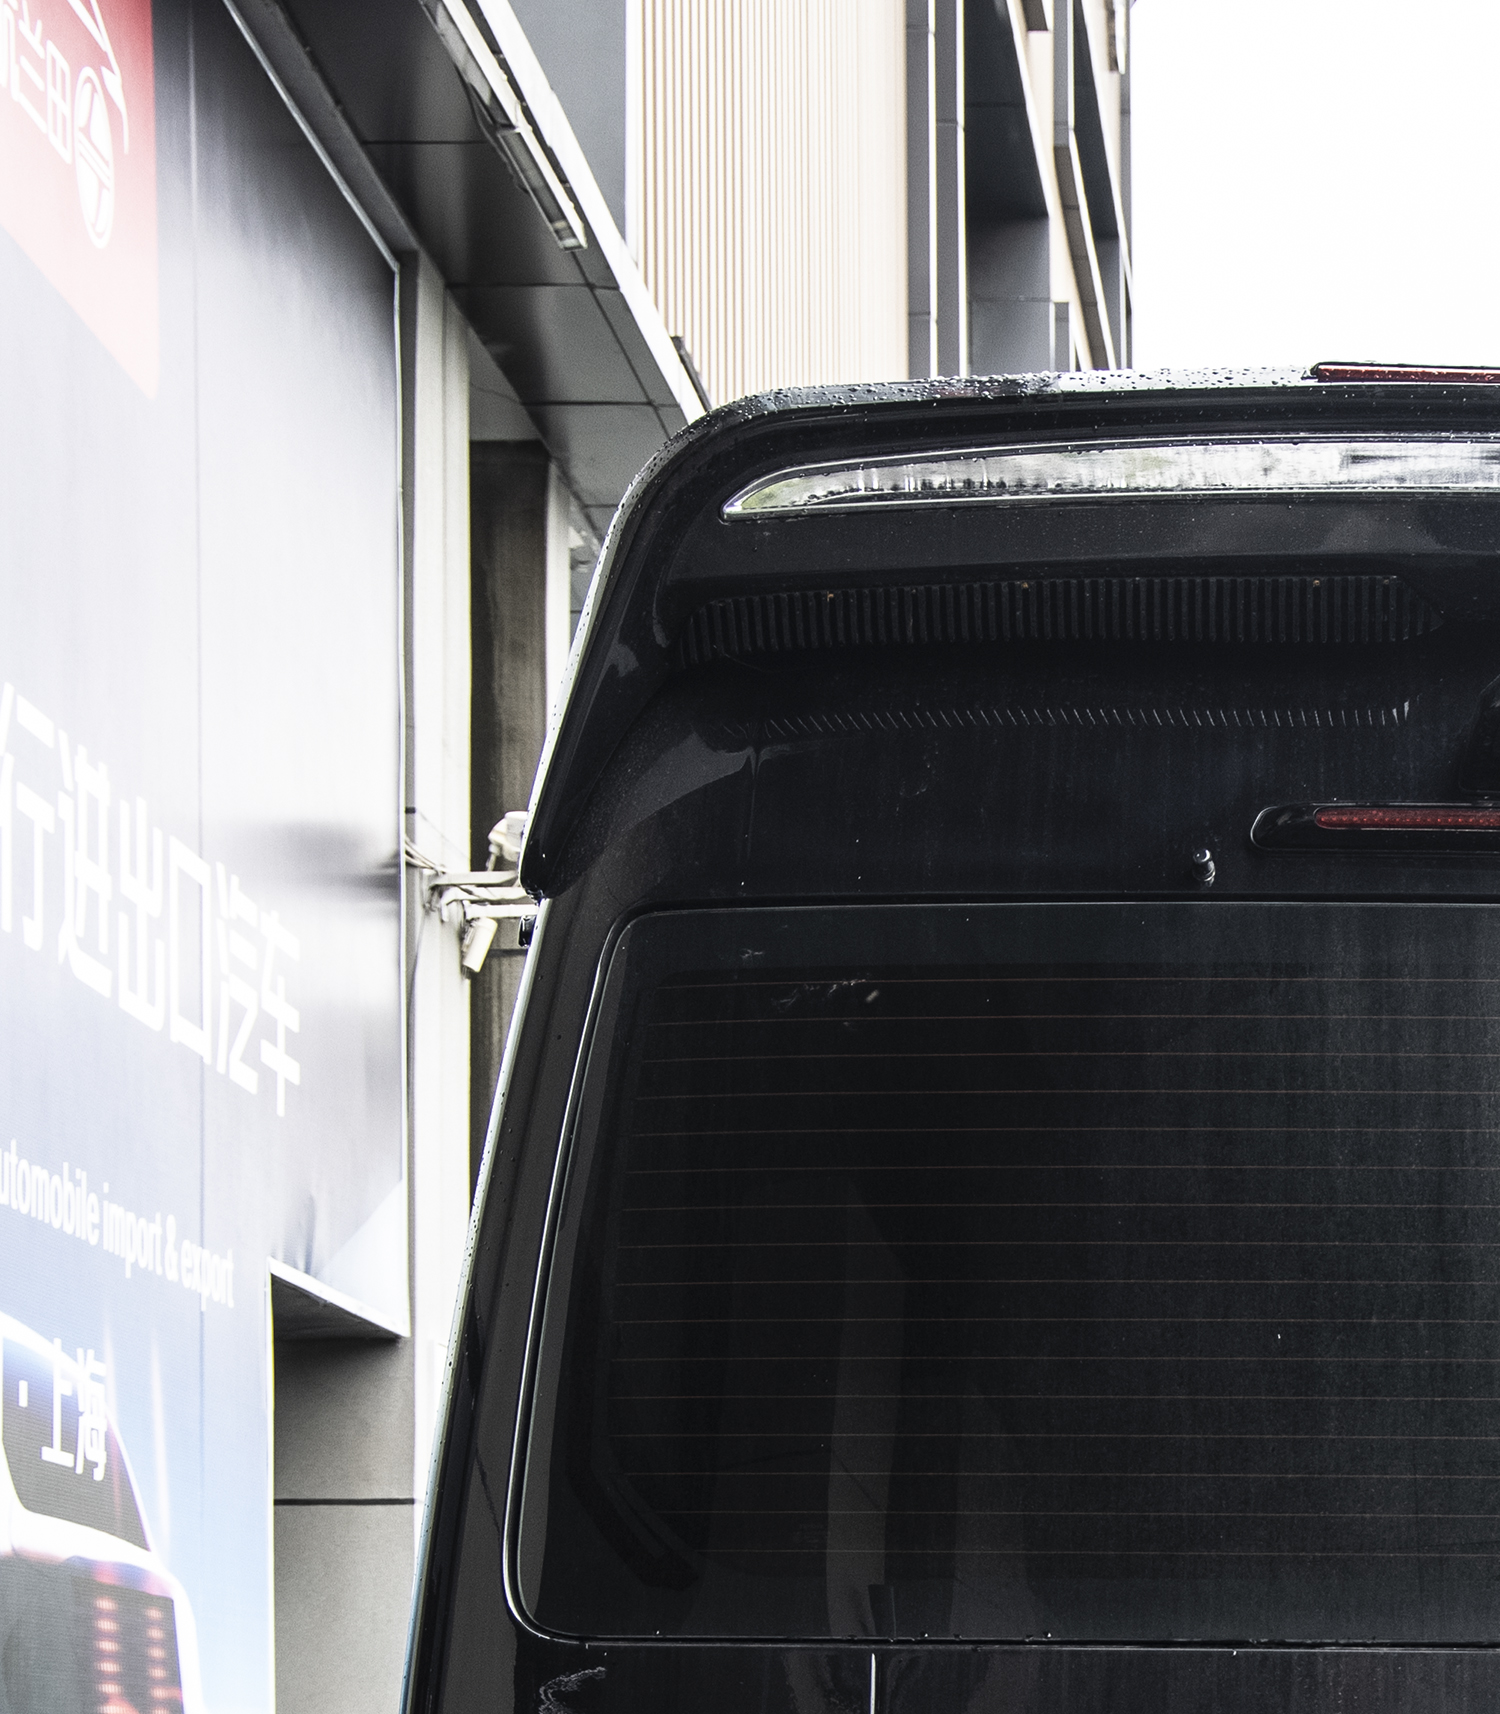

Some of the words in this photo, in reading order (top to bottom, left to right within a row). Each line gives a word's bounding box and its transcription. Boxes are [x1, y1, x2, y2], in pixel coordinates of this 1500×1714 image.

[102, 1181, 163, 1279] import
[164, 1213, 180, 1283] &
[180, 1239, 235, 1312] export
